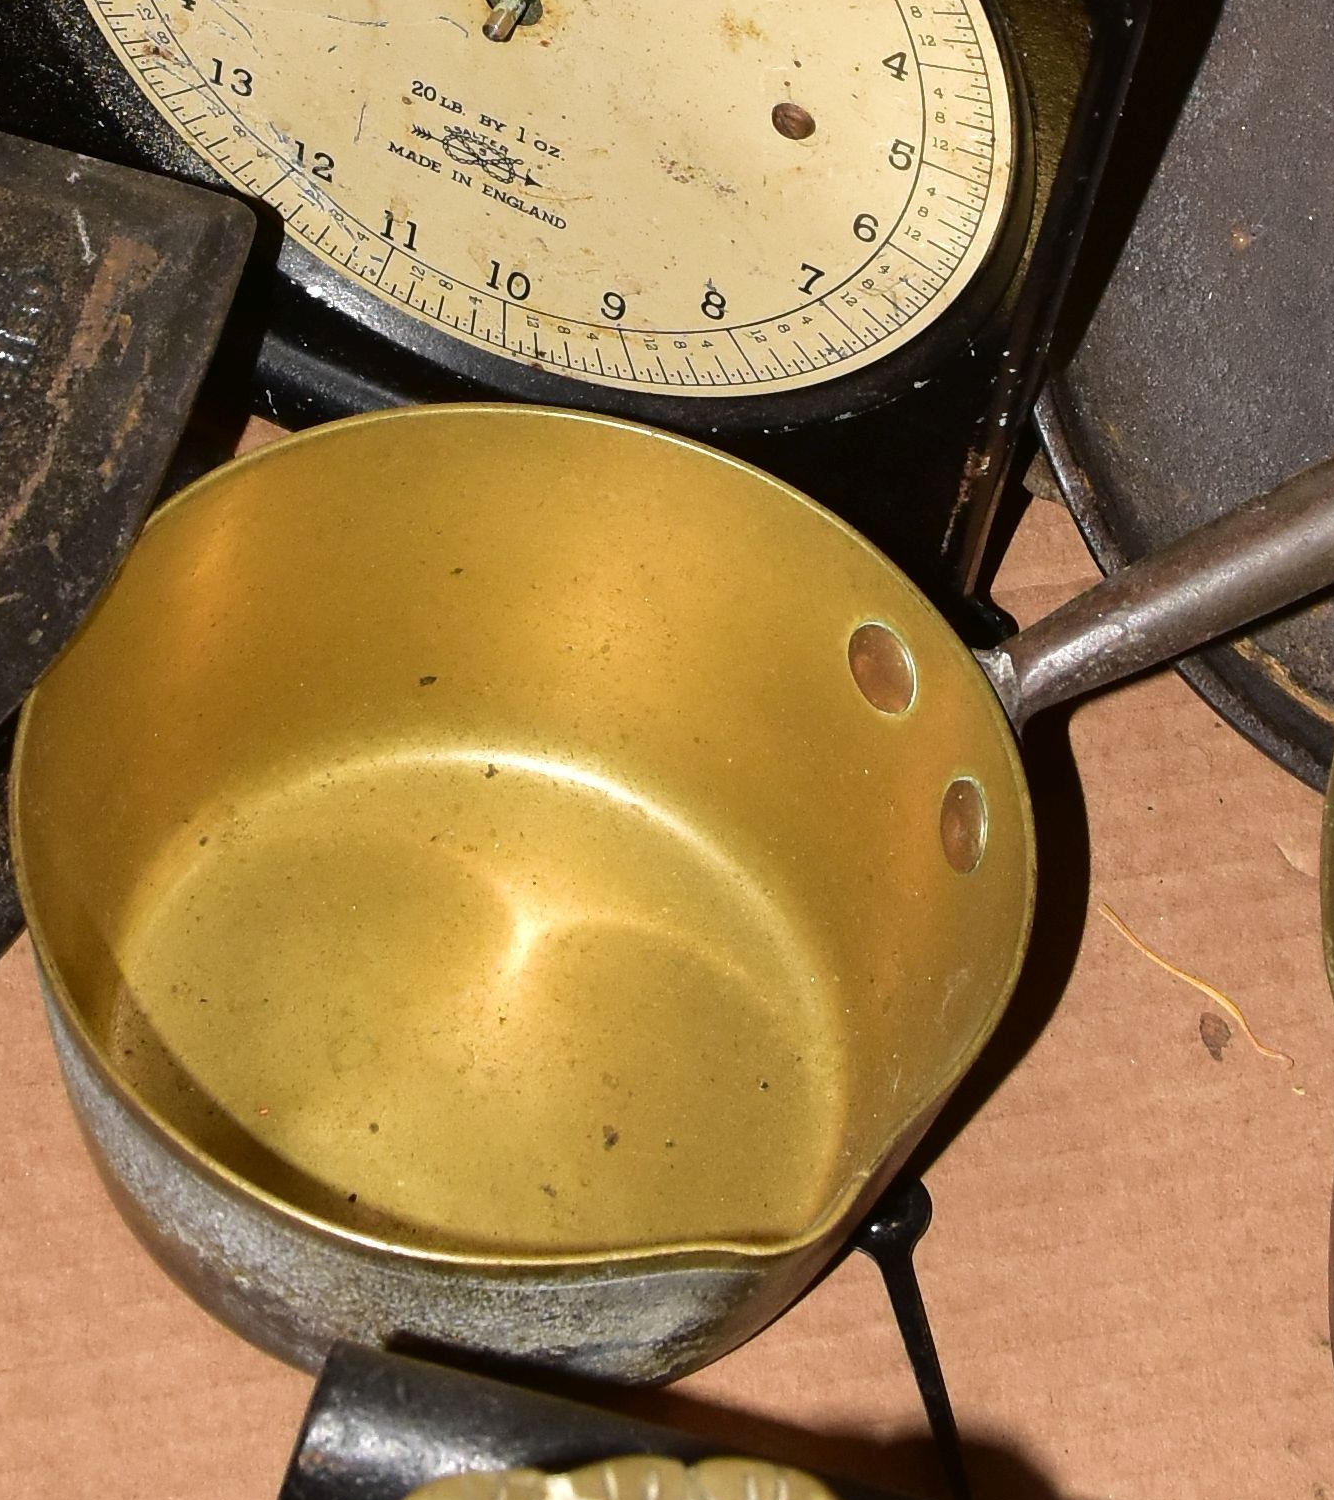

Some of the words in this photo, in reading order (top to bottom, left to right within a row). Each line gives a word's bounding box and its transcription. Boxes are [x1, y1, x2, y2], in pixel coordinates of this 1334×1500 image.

[136, 7, 156, 21] 12
[909, 5, 923, 18] 8
[156, 31, 170, 44] 8
[919, 34, 937, 47] 12
[881, 51, 909, 82] 4
[209, 57, 254, 97] 13
[933, 87, 944, 99] 4
[411, 80, 437, 102] 20
[479, 113, 507, 133] BY
[516, 126, 526, 144] 1
[935, 112, 946, 124] 8
[232, 125, 247, 138] 8
[932, 137, 949, 151] 12
[294, 140, 335, 183] 12
[888, 139, 916, 171] 5
[387, 141, 443, 174] MADE
[451, 169, 472, 188] IN
[482, 183, 567, 230] ENGLAND
[926, 187, 936, 197] 4
[918, 206, 929, 218] 8
[380, 210, 418, 252] 11
[852, 213, 879, 243] 6
[903, 225, 922, 241] 12
[357, 230, 370, 242] 4
[409, 264, 426, 282] 12
[486, 259, 531, 300] 10
[798, 262, 826, 295] 7
[438, 279, 454, 291] 8
[861, 278, 875, 290] 8
[700, 290, 726, 320] 8
[840, 290, 858, 307] 12
[600, 291, 626, 321] 9
[526, 314, 540, 329] 12
[801, 315, 814, 326] 4
[557, 325, 571, 335] 8
[777, 323, 791, 334] 8
[586, 332, 599, 342] 4
[701, 339, 714, 348] 4
[750, 329, 767, 344] 12
[643, 337, 659, 351] 12
[673, 339, 687, 349] 8
